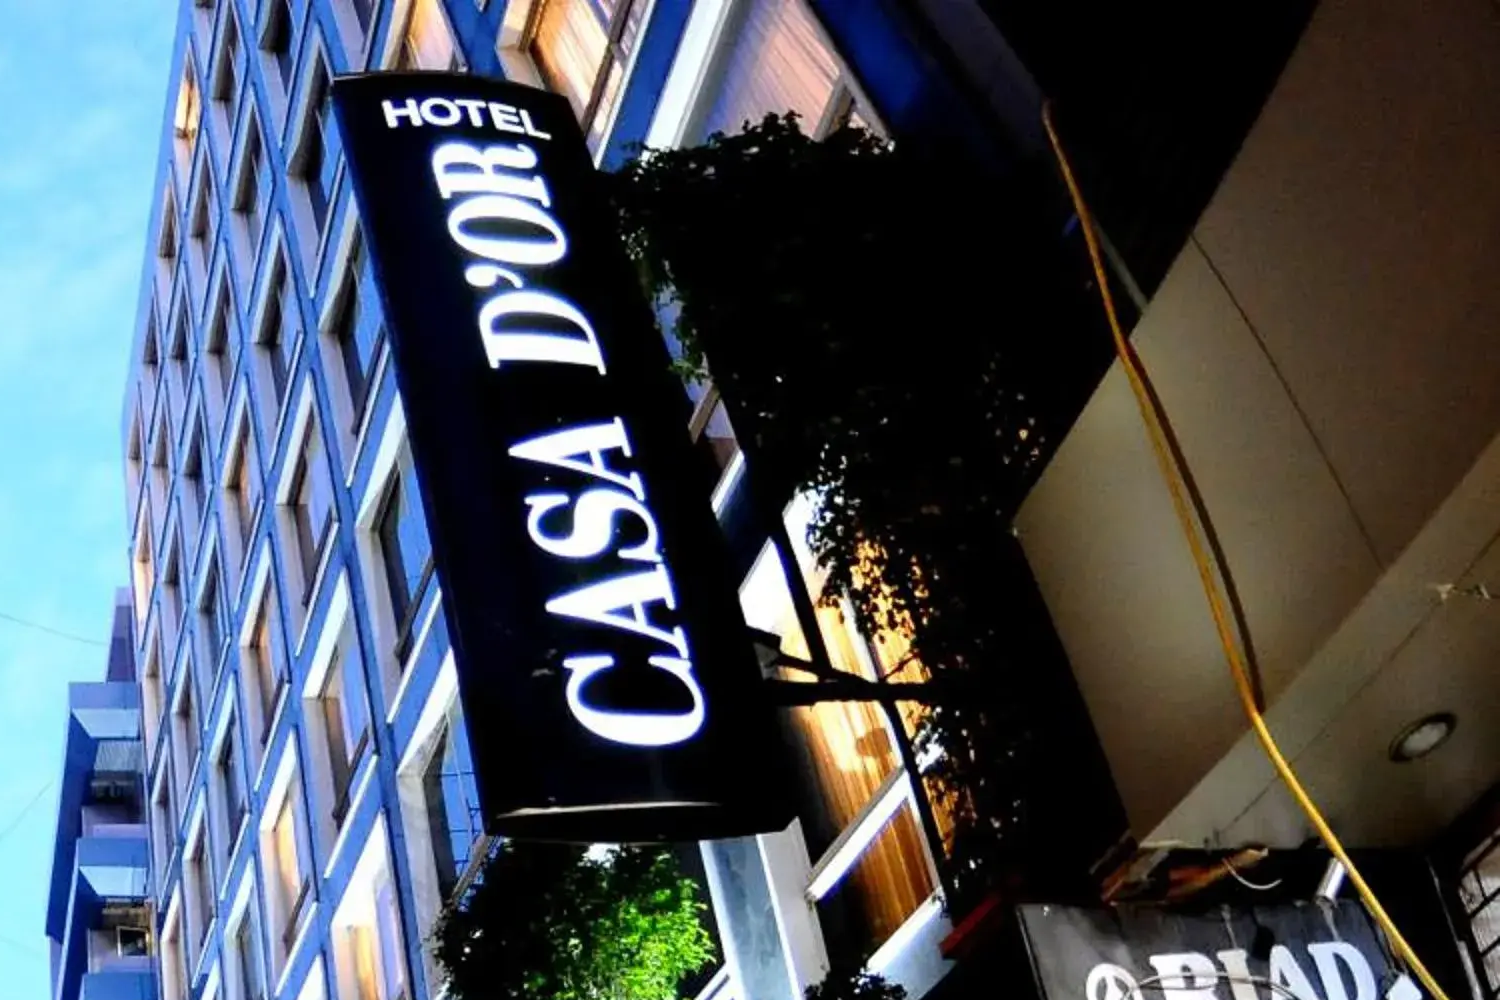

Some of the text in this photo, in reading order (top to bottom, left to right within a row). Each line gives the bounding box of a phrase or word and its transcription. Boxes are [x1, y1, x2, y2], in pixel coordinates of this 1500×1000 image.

[382, 96, 551, 142] HOTEL
[431, 141, 706, 748] CASA D'OR
